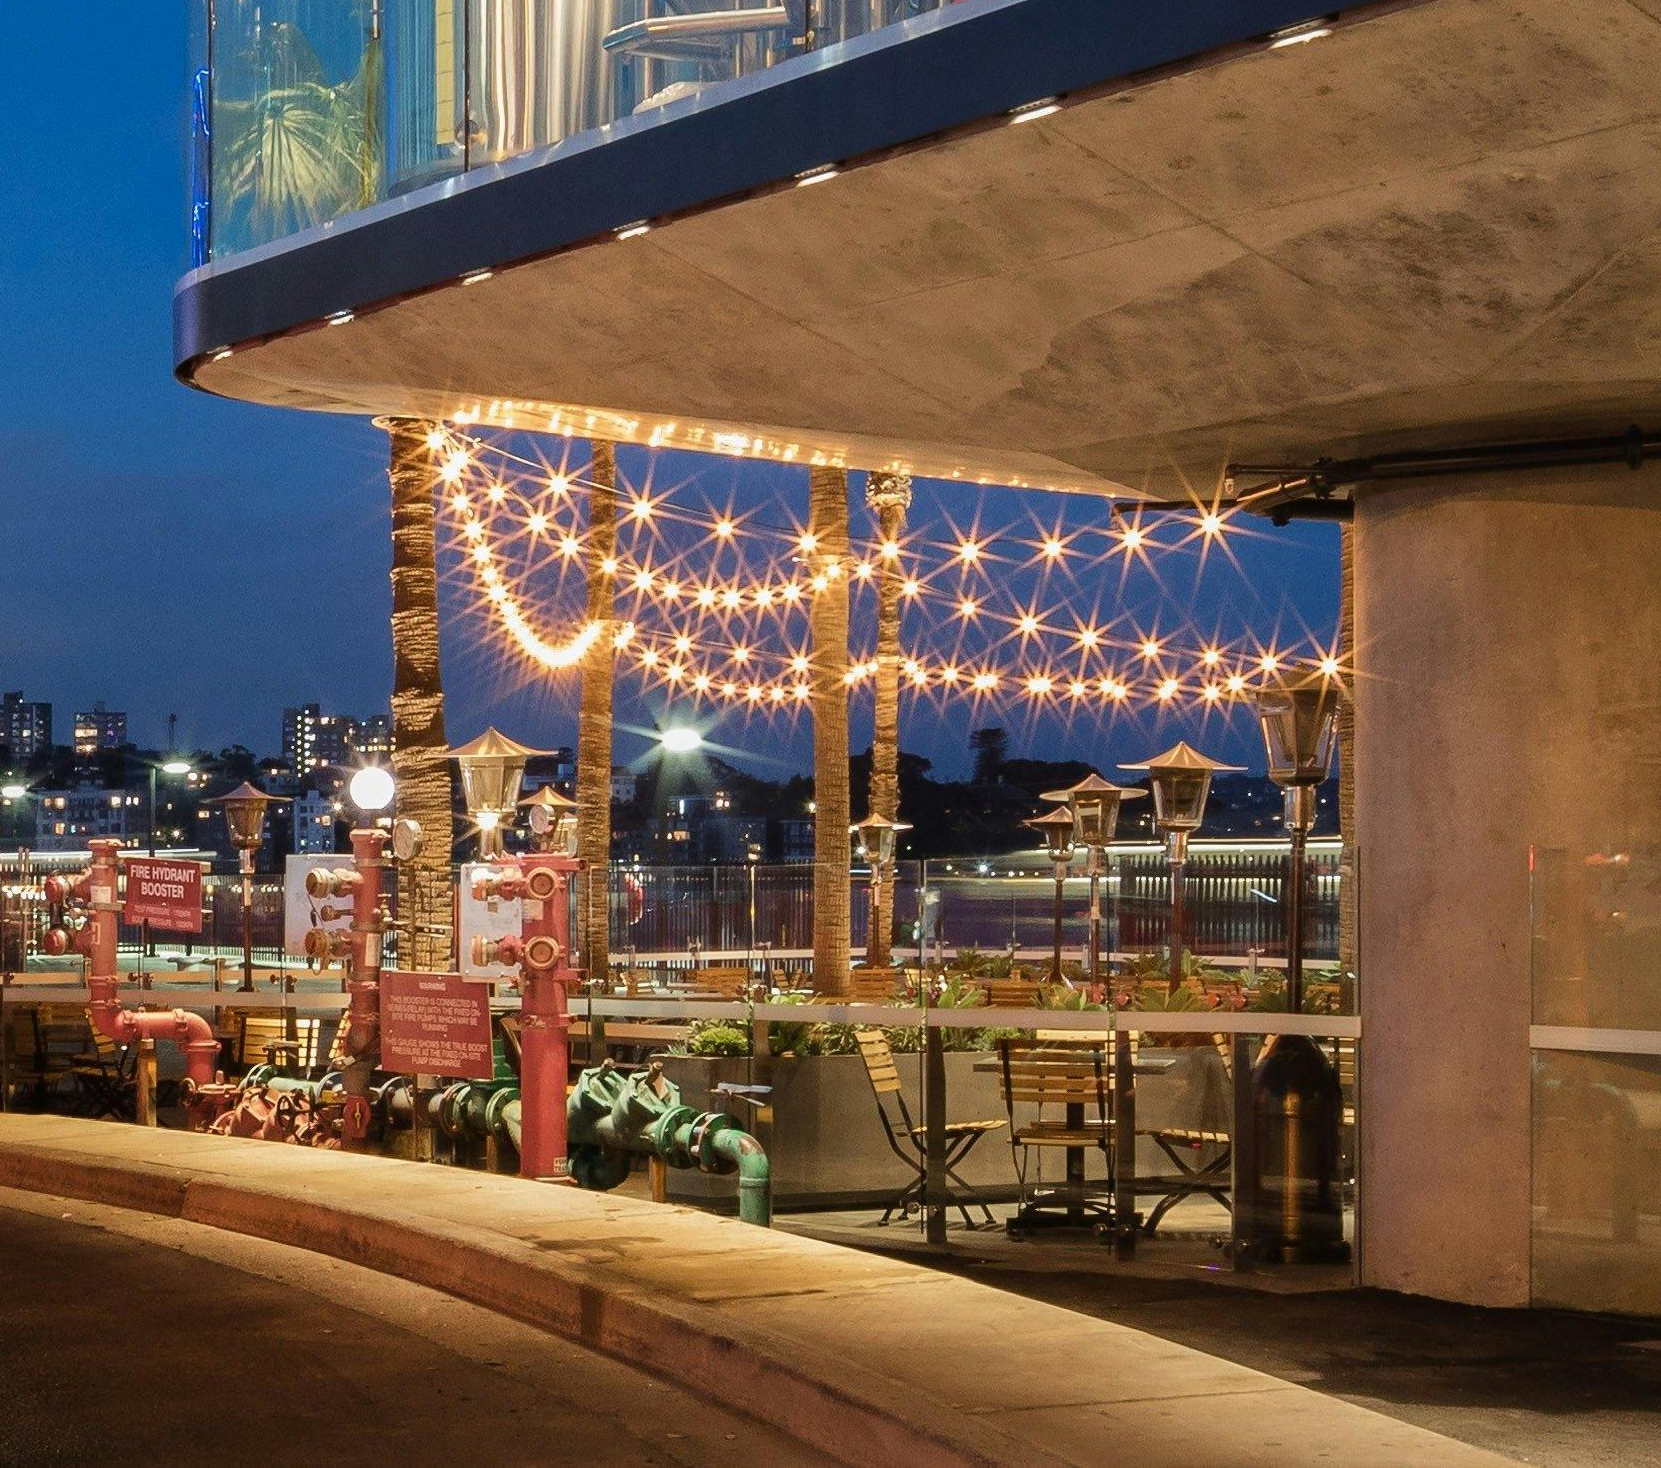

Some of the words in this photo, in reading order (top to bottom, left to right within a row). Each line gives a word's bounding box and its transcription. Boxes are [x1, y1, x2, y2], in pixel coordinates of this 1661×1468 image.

[130, 865, 151, 880] FIRE
[152, 866, 195, 883] HYDRANT
[141, 882, 184, 899] BOOSTER
